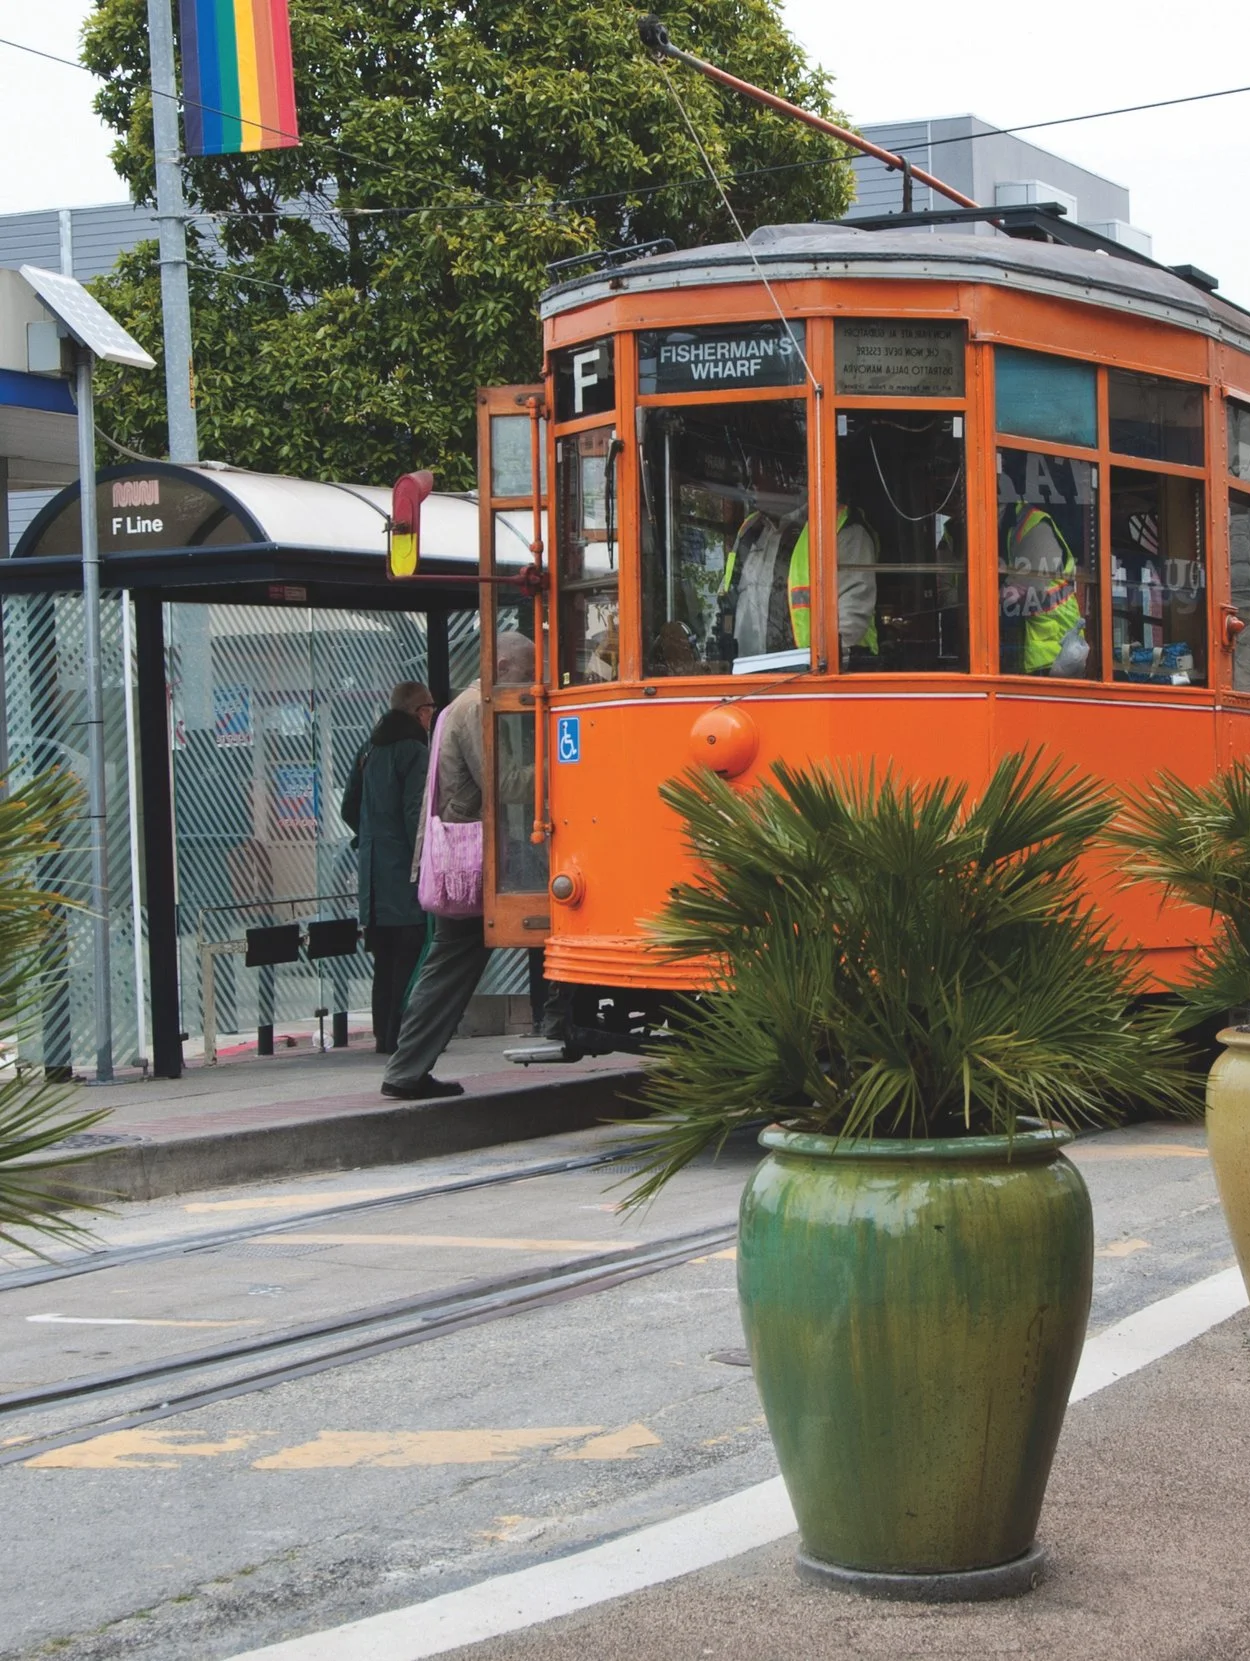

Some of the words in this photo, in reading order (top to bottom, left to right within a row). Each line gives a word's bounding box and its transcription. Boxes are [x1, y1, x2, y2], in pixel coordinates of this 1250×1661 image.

[660, 337, 793, 363] FISHERMAN'S
[573, 348, 601, 413] F
[690, 359, 762, 380] WHARF
[112, 517, 123, 535] F
[126, 516, 164, 534] Line
